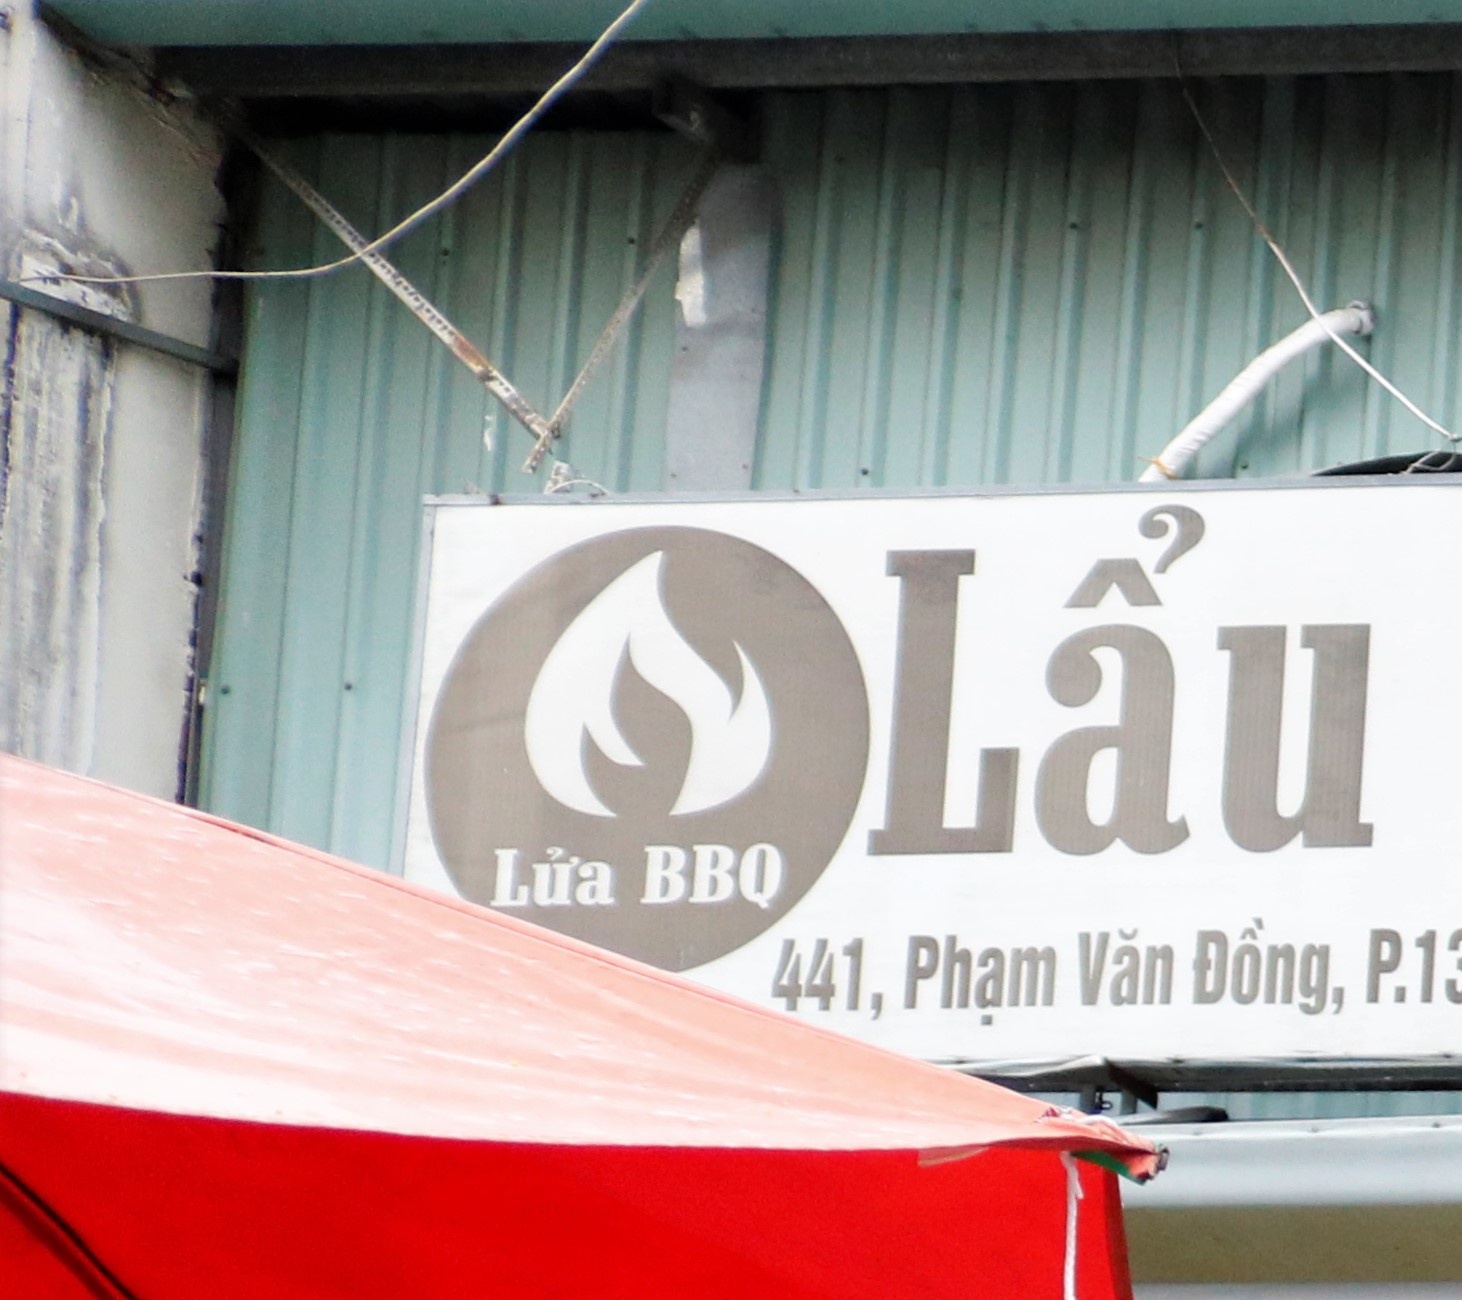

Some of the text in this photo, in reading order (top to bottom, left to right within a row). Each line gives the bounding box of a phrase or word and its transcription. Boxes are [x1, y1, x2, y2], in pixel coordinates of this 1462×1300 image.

[868, 505, 1373, 856] Lẩu
[490, 843, 783, 909] Lửa BBQ
[771, 938, 883, 1020] 441,
[906, 934, 1056, 1026] Phạm
[1077, 927, 1172, 1006] Văn
[1192, 914, 1344, 1016] Đồng,
